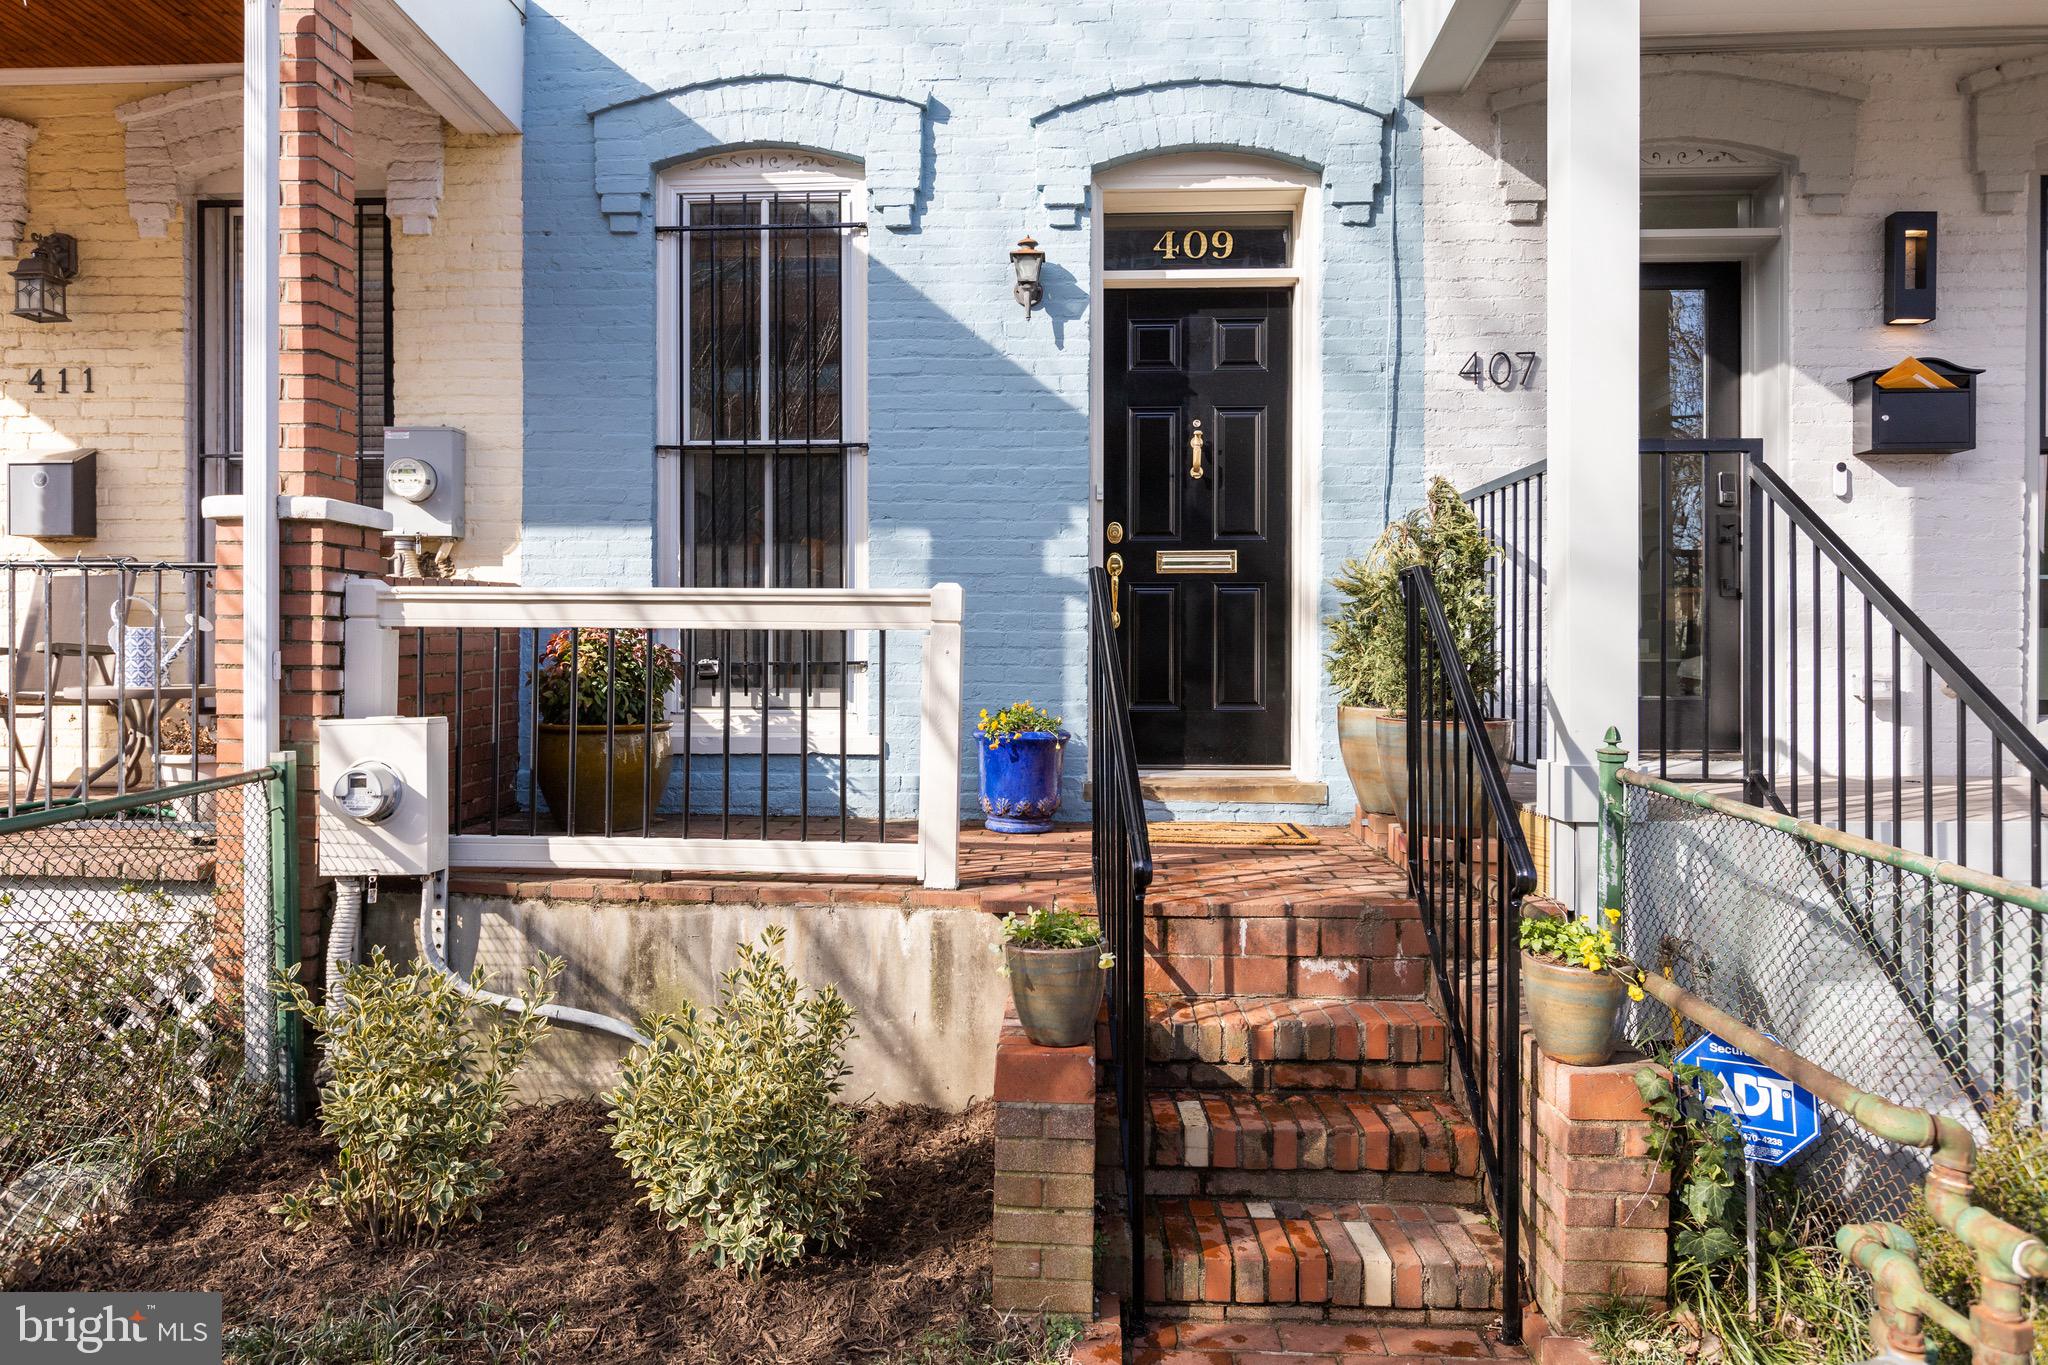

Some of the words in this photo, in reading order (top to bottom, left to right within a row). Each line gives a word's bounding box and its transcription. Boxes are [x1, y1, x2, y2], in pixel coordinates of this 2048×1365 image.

[1153, 230, 1234, 260] 409
[28, 367, 95, 394] 411
[1458, 351, 1536, 386] 407
[1703, 1071, 1793, 1122] ADT
